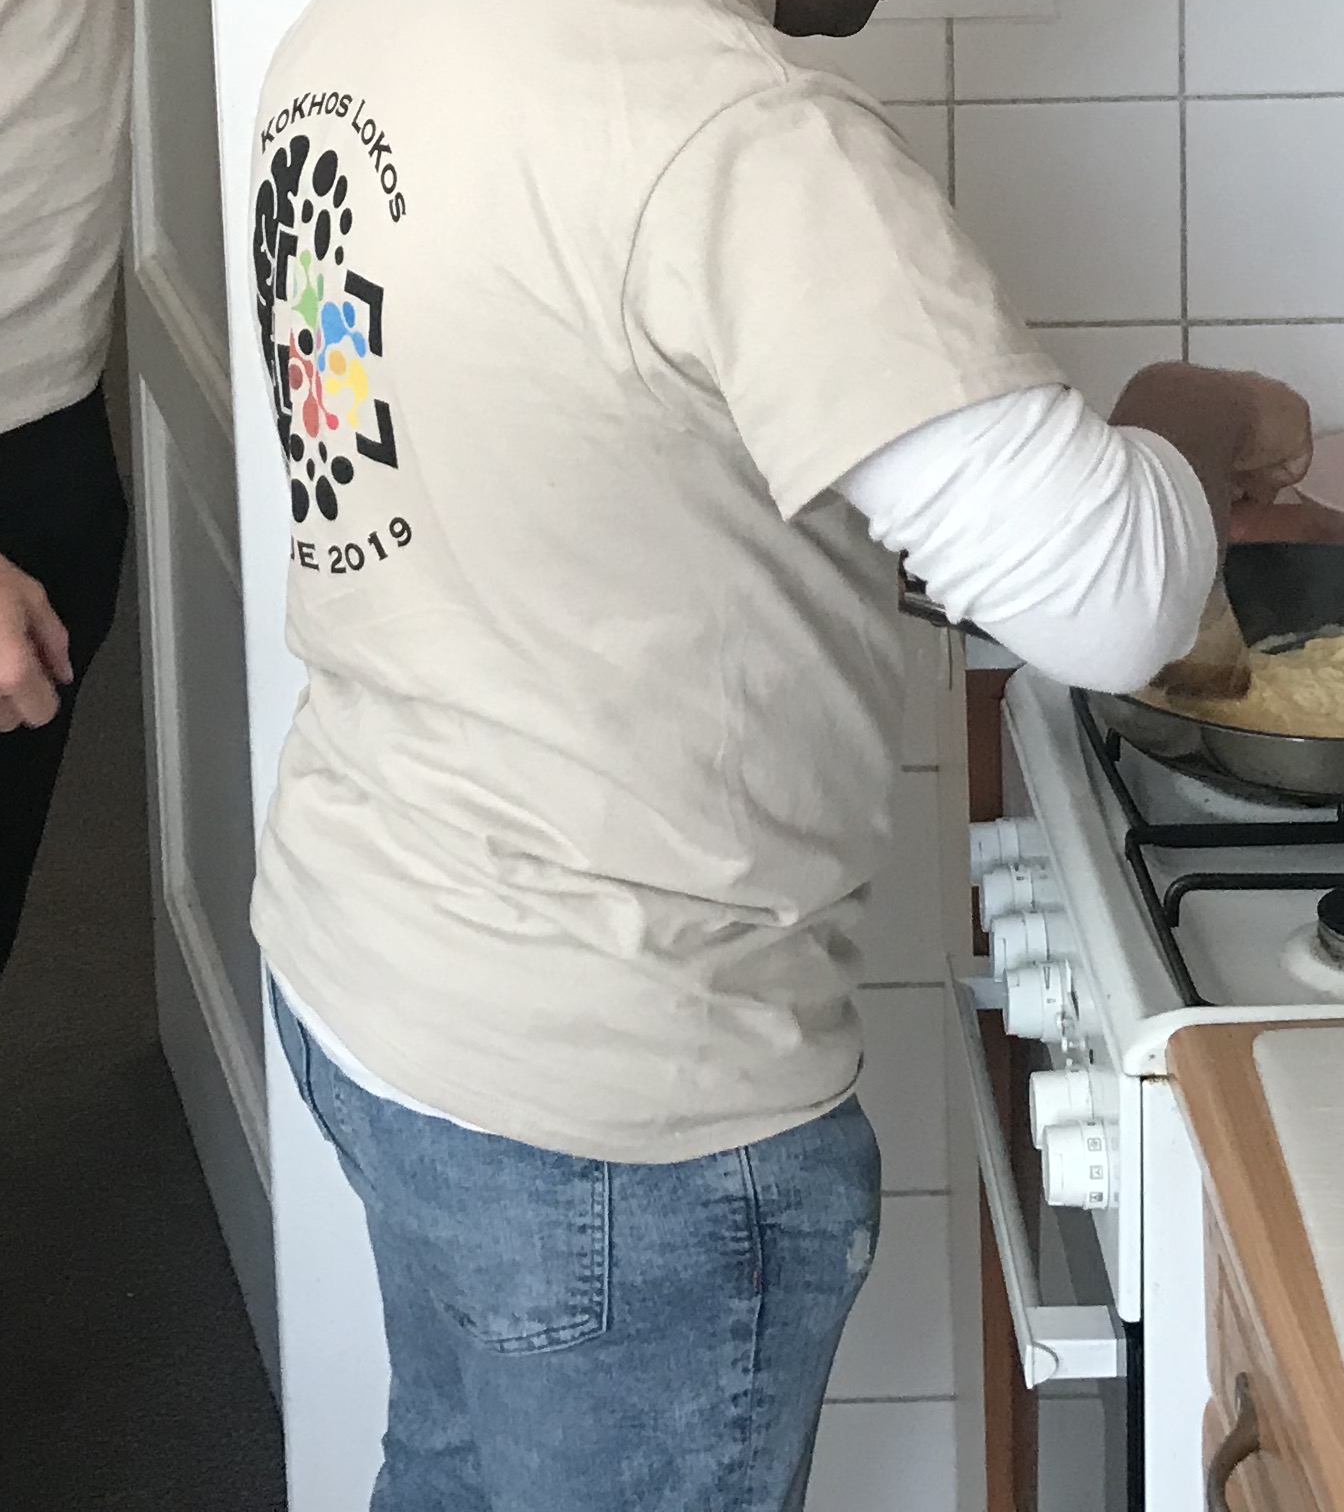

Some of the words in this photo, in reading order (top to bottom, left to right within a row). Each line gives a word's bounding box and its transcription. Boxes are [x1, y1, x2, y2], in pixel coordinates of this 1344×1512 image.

[260, 91, 354, 154] KOKHOS
[351, 99, 407, 223] LOKOS
[328, 516, 413, 574] 2019
